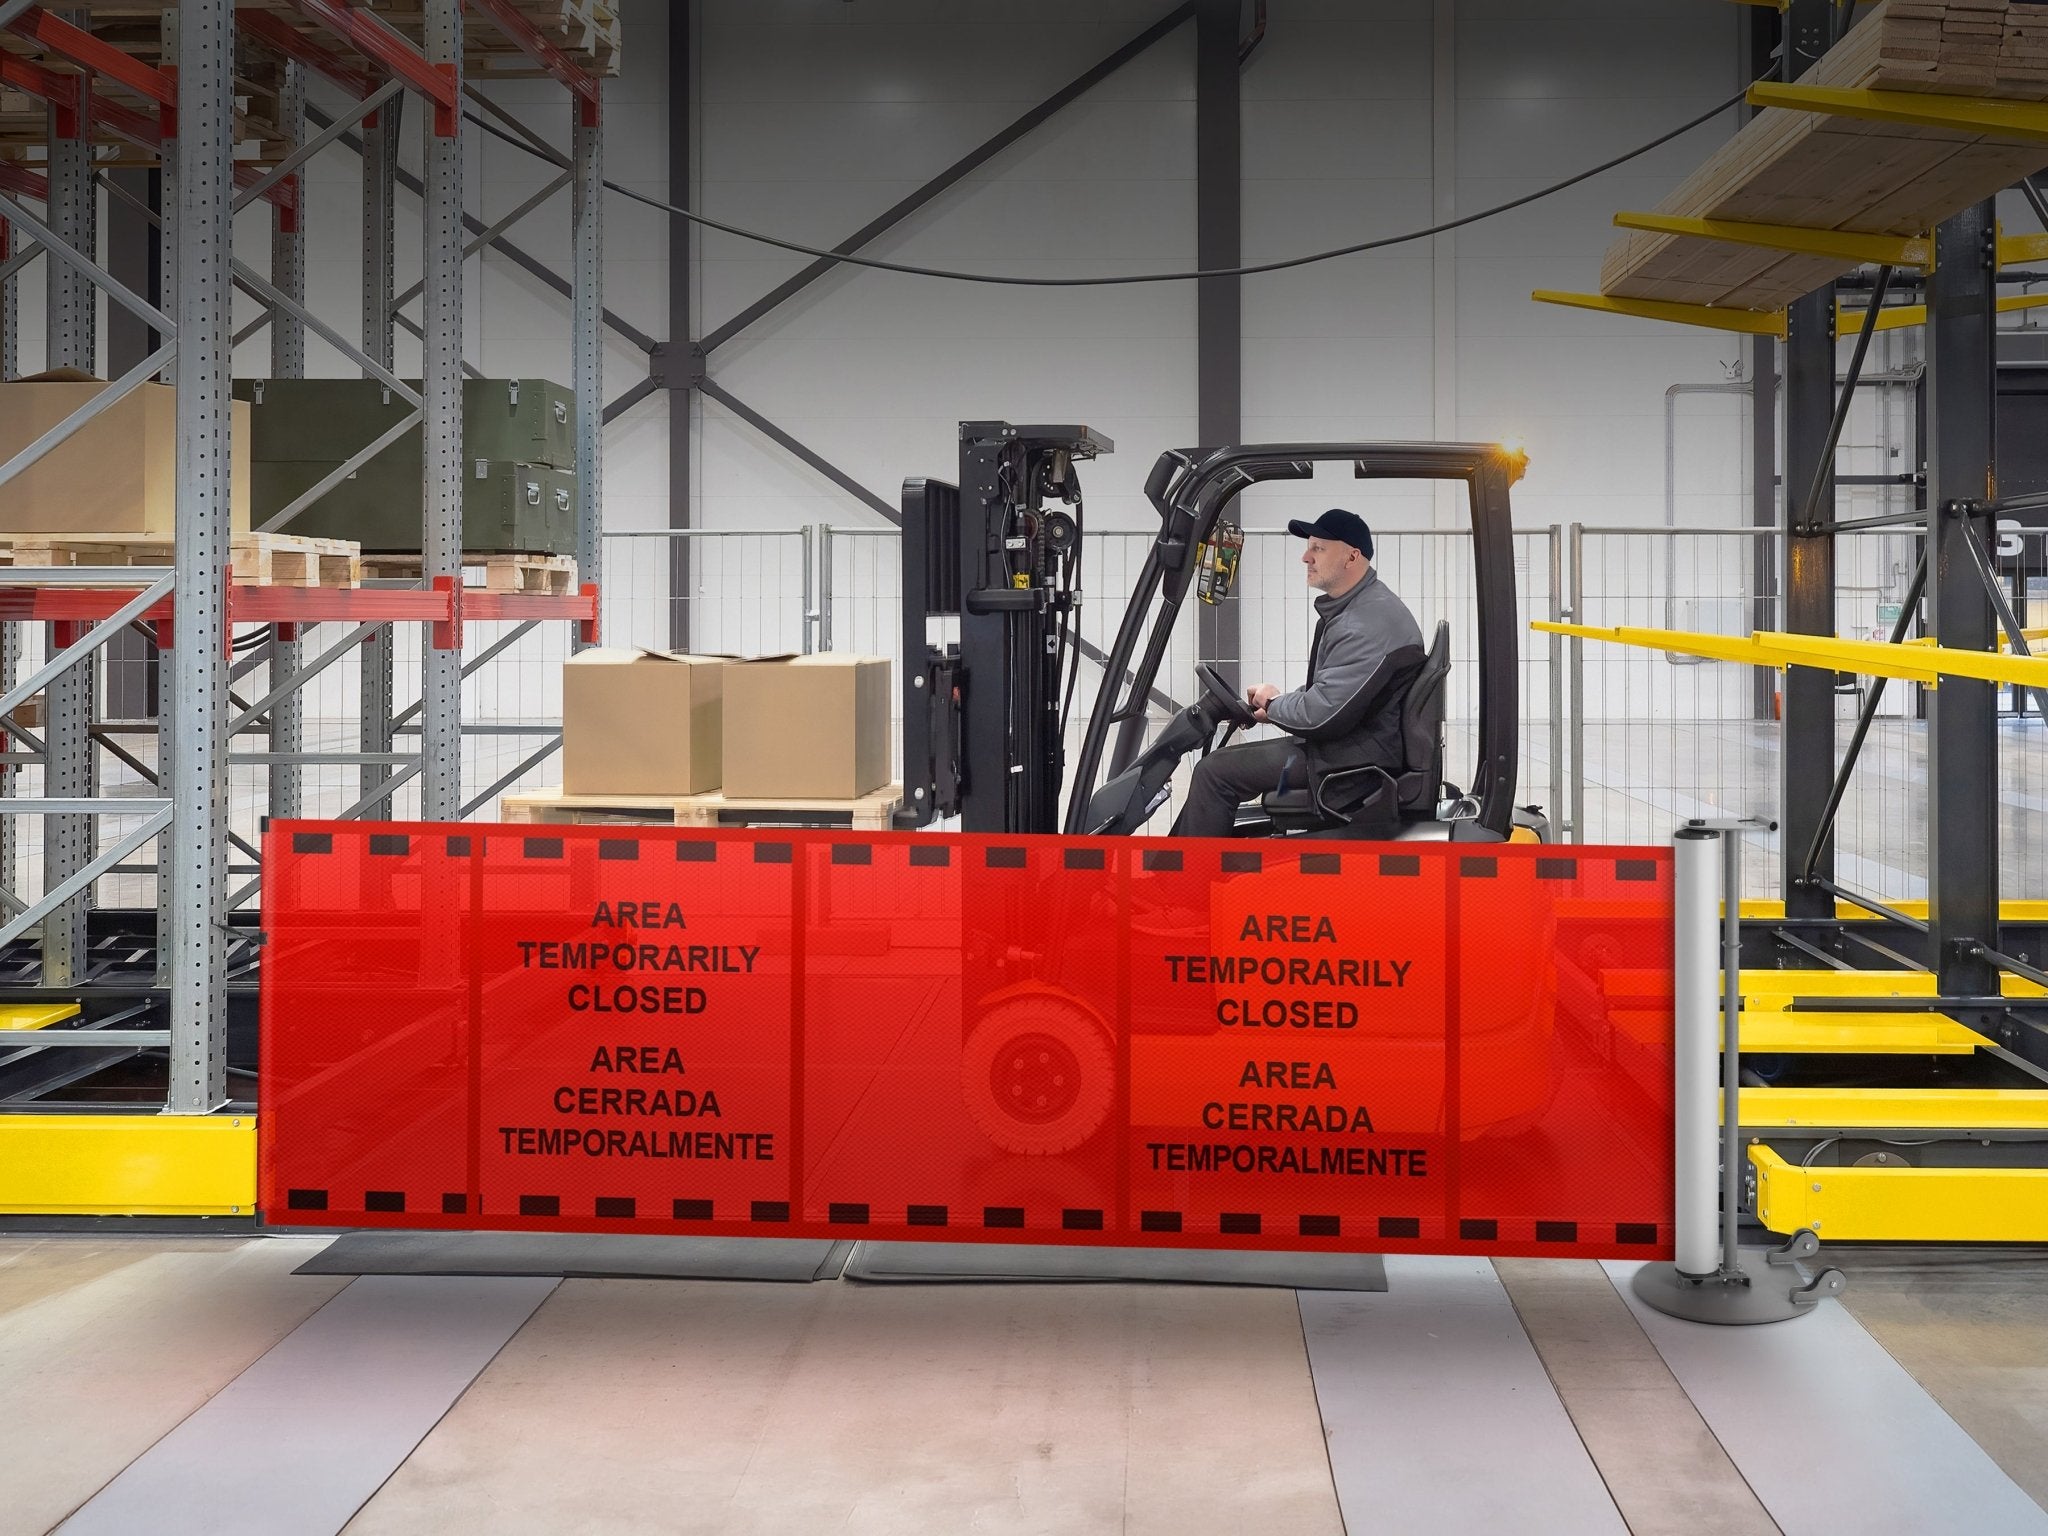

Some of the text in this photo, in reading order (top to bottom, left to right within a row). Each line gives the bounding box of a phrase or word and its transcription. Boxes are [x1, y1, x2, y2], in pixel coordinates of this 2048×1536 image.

[591, 901, 686, 929] AREA
[1240, 915, 1337, 943] AREA
[519, 942, 760, 973] TEMPORARILY
[1168, 957, 1412, 987] TEMPORARILY
[568, 984, 707, 1014] CLOSED
[1217, 999, 1358, 1029] CLOSED
[590, 1046, 685, 1074] AREA
[1239, 1061, 1336, 1089] AREA
[554, 1087, 721, 1117] CERRADA
[1202, 1102, 1374, 1133] CERRADA
[499, 1127, 773, 1160] TEMPORALMENTE
[1147, 1143, 1427, 1176] TEMPORALMENTE
